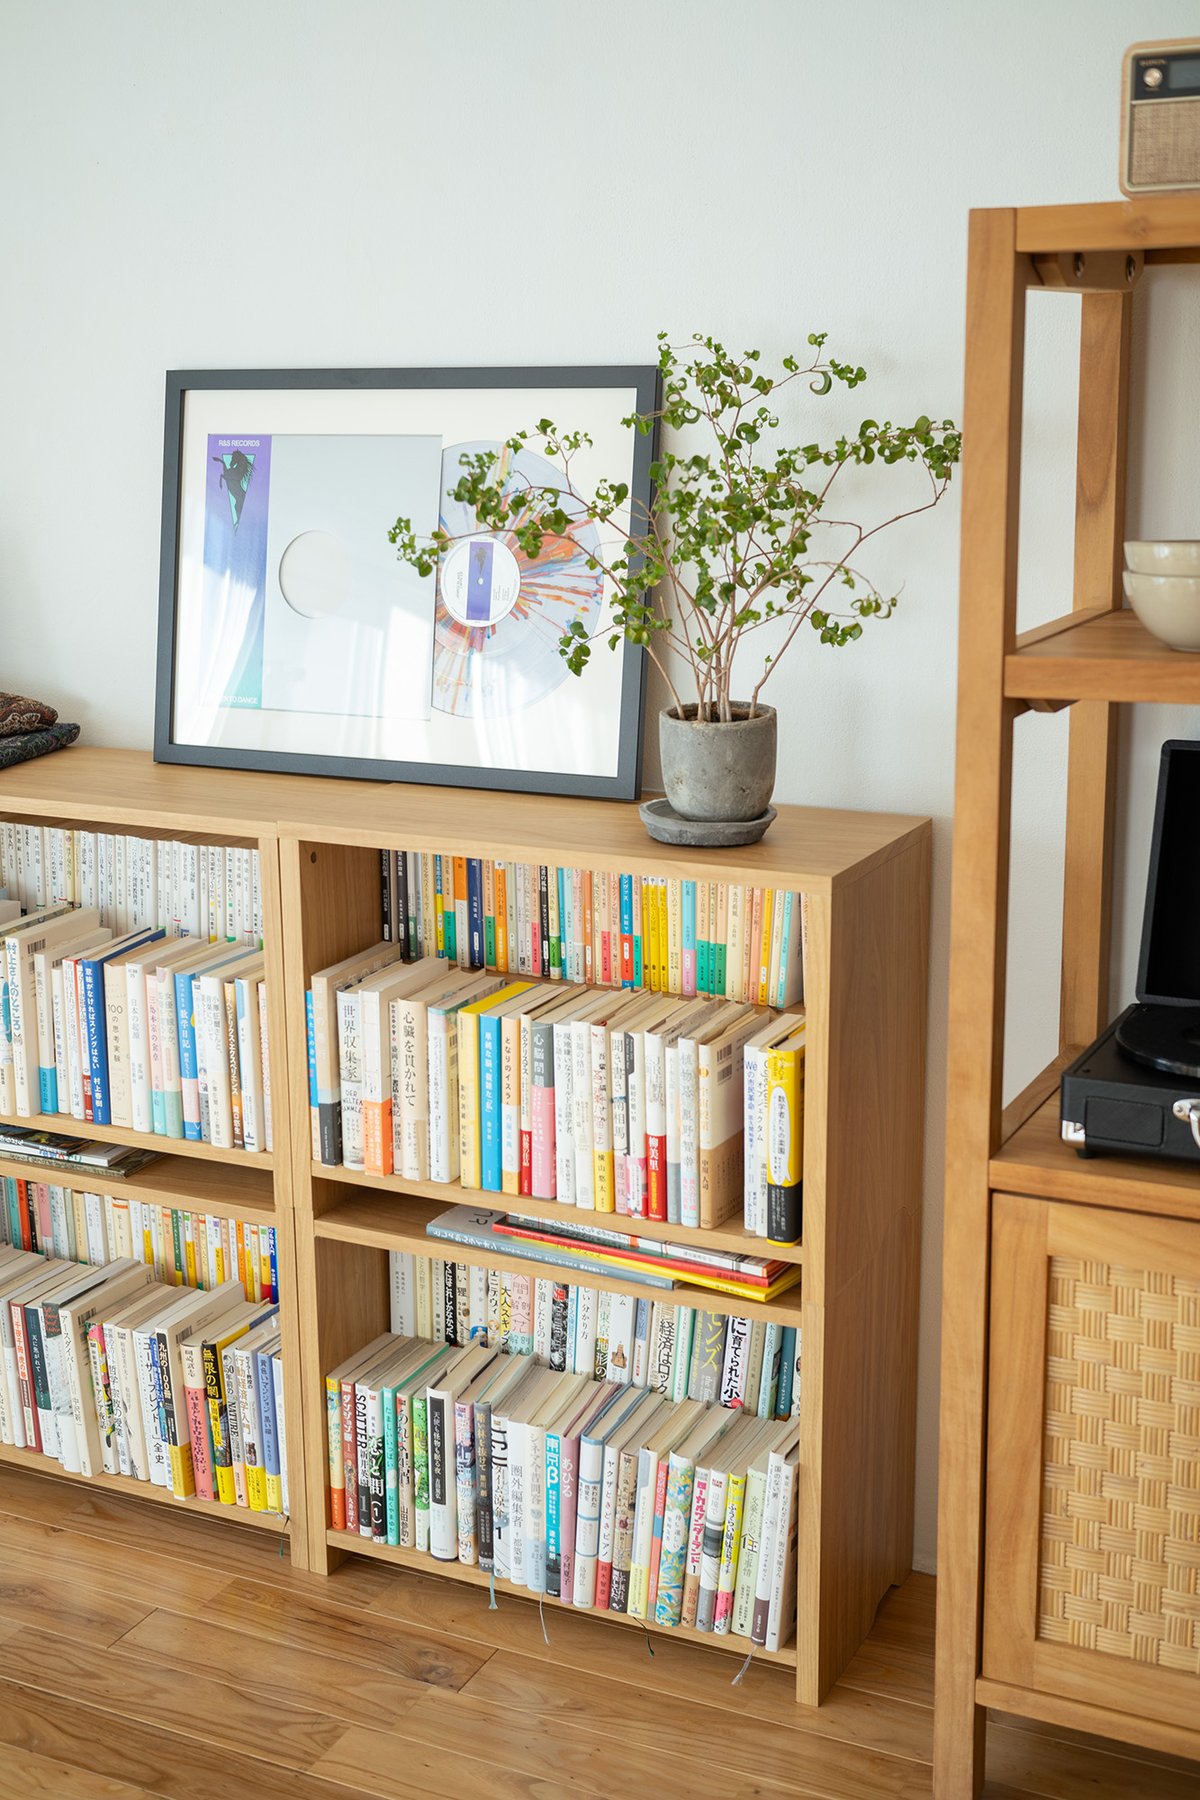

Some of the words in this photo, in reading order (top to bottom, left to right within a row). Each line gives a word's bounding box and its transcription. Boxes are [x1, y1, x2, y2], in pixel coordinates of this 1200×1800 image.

[343, 1004, 358, 1080] 世界収集家
[403, 1011, 417, 1107] 心臓を貫かれて
[504, 1036, 512, 1105] となりのイスラ
[533, 1033, 545, 1088] 心脳問題
[648, 1136, 659, 1171] 柳美里
[202, 1347, 220, 1399] 無限の網
[355, 1392, 369, 1450] SCATTER
[511, 1463, 523, 1529] 圏外編集者
[561, 1457, 573, 1498] あひる
